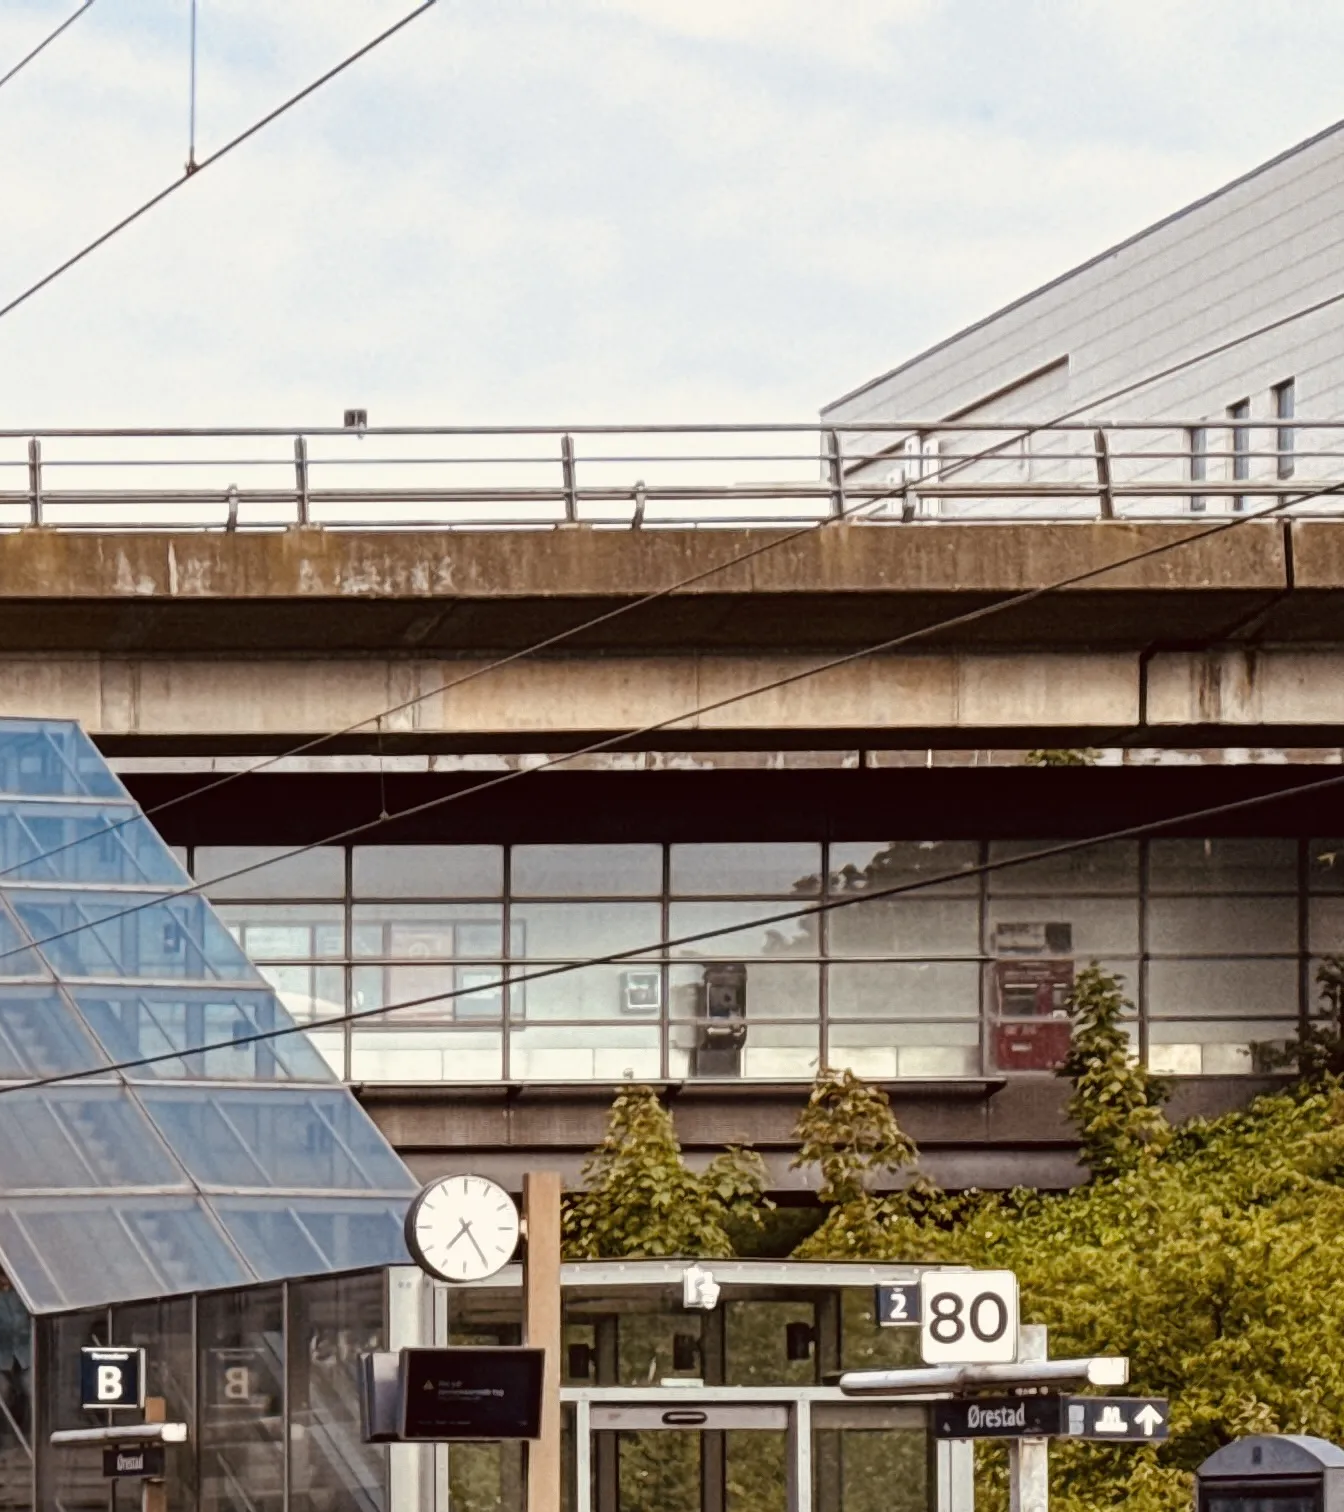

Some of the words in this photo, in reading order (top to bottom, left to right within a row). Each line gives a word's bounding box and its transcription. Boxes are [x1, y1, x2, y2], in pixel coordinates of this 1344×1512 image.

[889, 1293, 908, 1319] 2
[929, 1291, 1008, 1344] 80
[97, 1365, 122, 1400] B
[967, 1402, 1025, 1428] Ørestad
